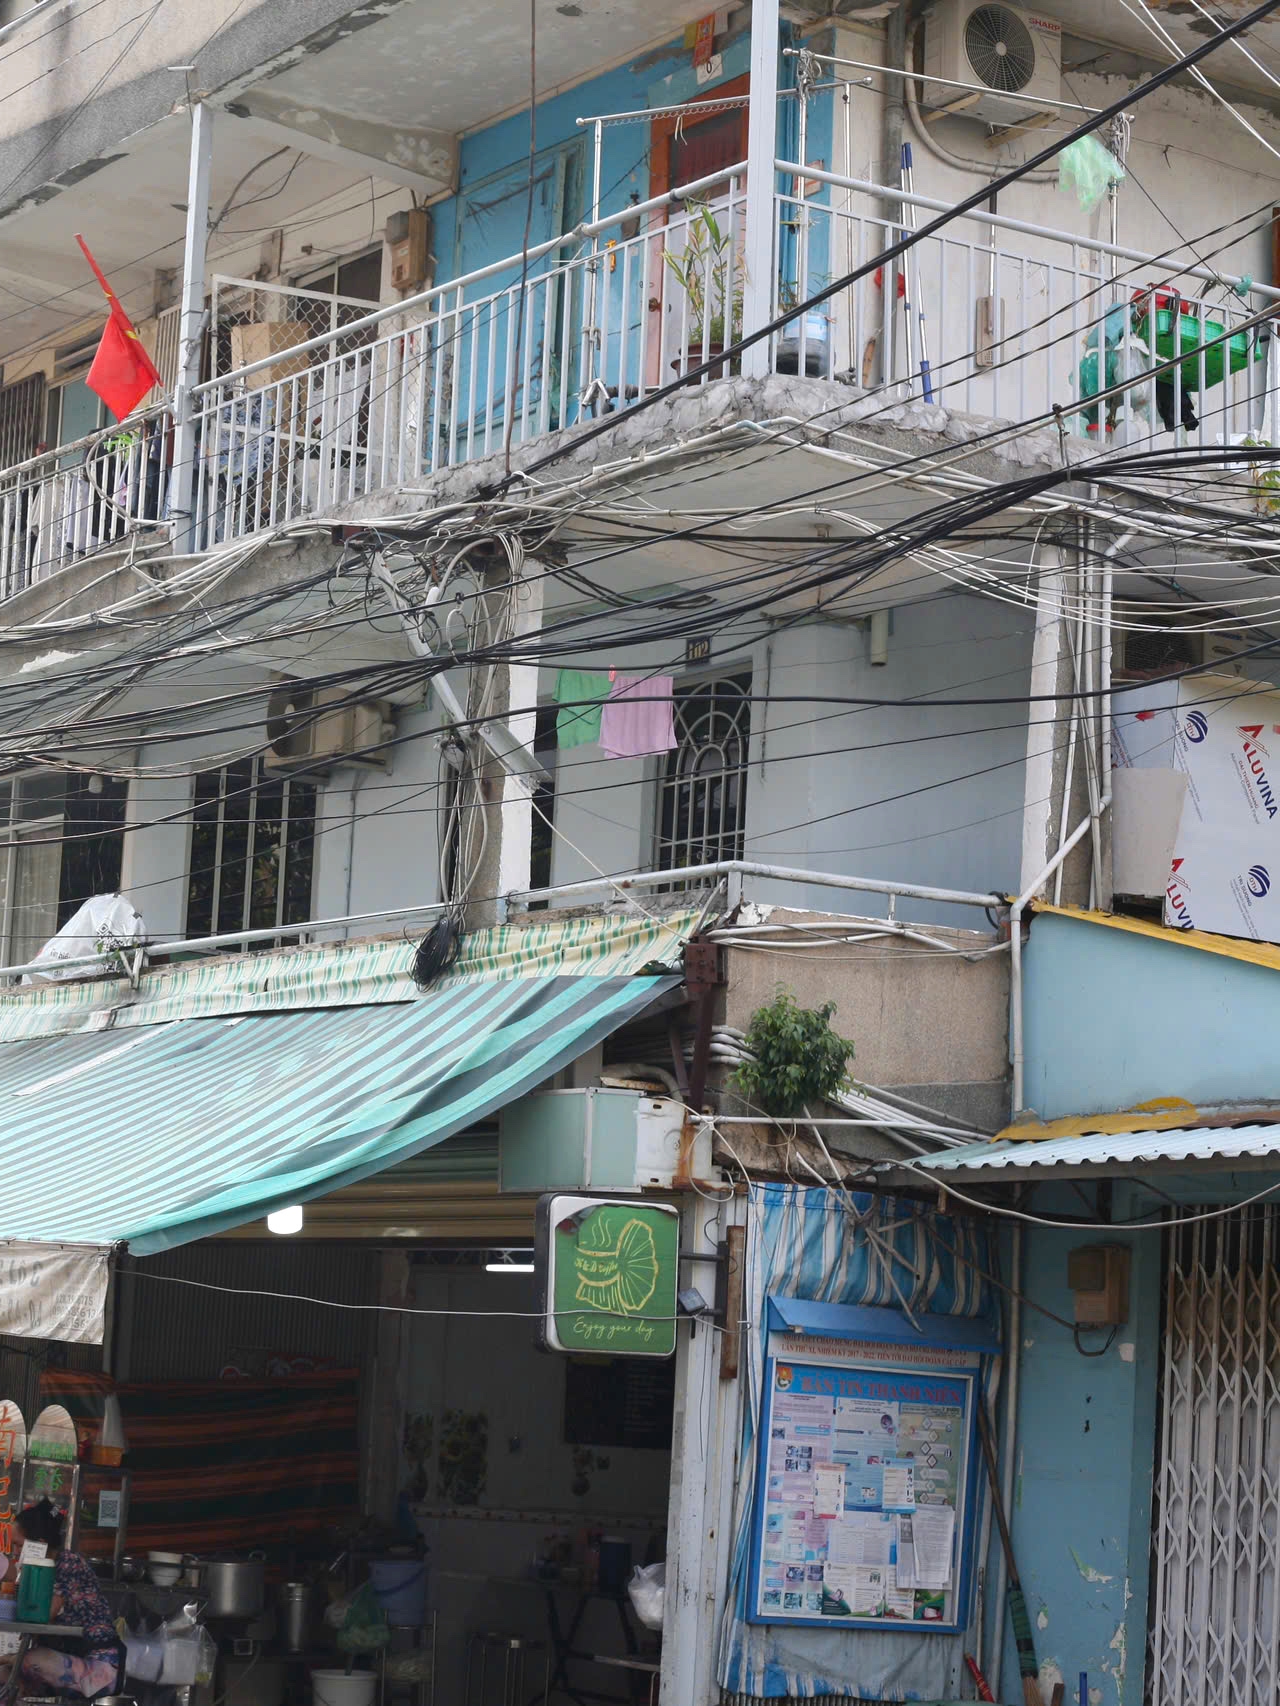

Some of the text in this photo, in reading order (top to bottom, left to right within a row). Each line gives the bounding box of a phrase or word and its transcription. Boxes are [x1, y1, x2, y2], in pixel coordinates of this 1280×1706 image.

[1028, 17, 1061, 31] SHARP
[1236, 724, 1278, 819] ALUVINA
[30, 1261, 43, 1287] C
[573, 1315, 655, 1343] Enjoy your day
[839, 1378, 864, 1396] TIN
[869, 1382, 920, 1401] THANH
